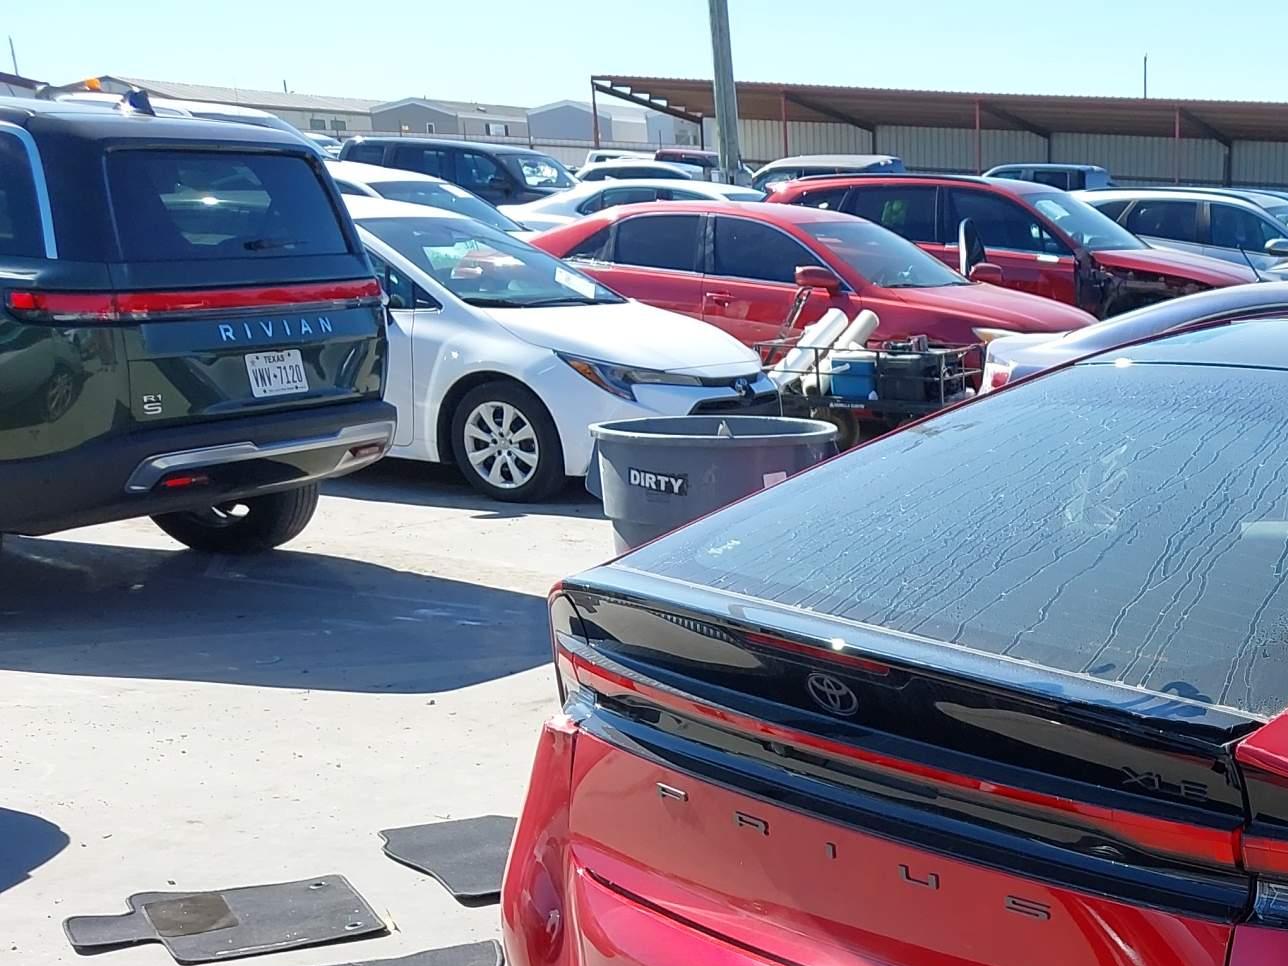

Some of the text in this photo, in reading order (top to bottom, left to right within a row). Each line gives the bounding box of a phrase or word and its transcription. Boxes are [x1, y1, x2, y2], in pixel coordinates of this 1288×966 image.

[218, 316, 333, 341] RIVIAN
[263, 354, 286, 364] TEXAS
[143, 393, 162, 403] R1
[143, 402, 162, 415] S
[630, 469, 684, 494] DIRTY
[1120, 766, 1209, 801] XLE
[656, 782, 1052, 920] PRIUS
